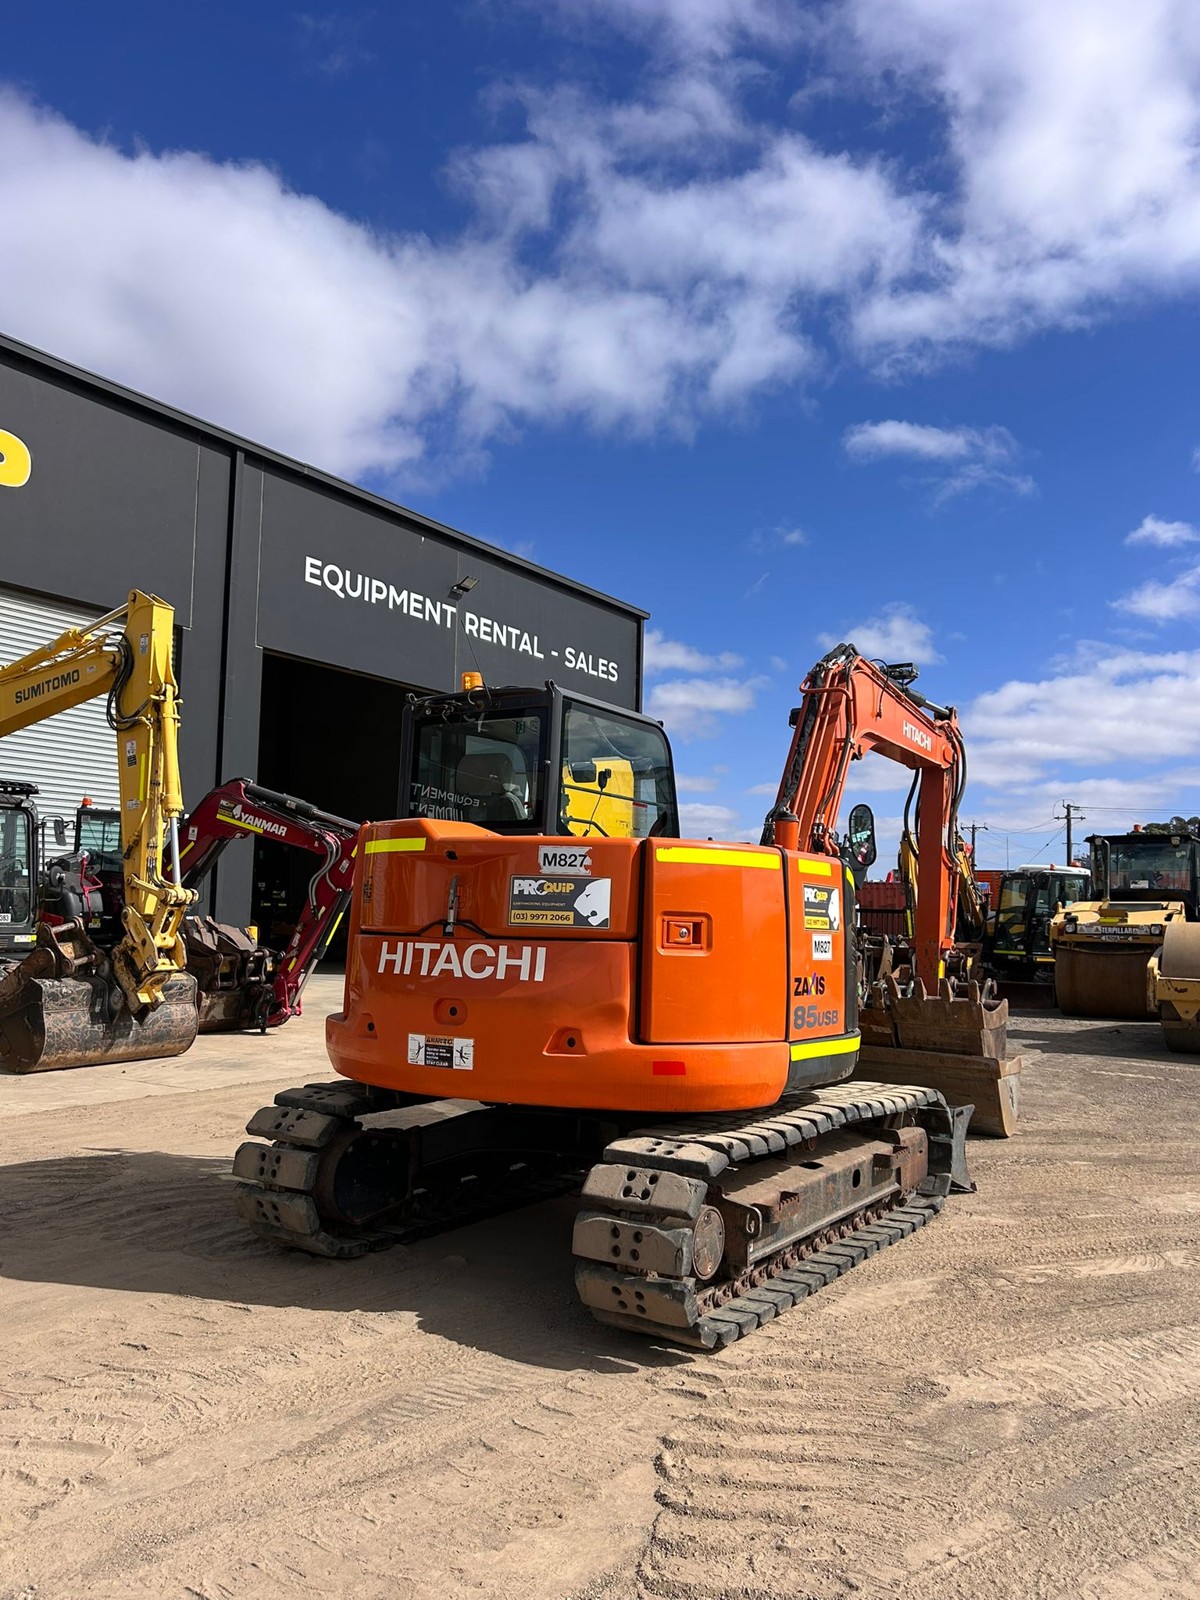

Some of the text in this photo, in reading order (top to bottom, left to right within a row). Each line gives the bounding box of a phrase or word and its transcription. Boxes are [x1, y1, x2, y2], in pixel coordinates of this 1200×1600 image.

[305, 556, 457, 628] EQUIPMENT
[465, 612, 544, 659] RENTAL
[565, 647, 619, 682] SALES
[15, 669, 80, 704] SUMITOMO
[903, 720, 932, 752] HITACHI
[241, 812, 287, 837] YANMAR
[542, 853, 587, 867] M827
[513, 913, 528, 921] (03)
[814, 940, 831, 953] M827
[378, 941, 547, 982] HITACHI
[794, 972, 825, 996] ZAXIS
